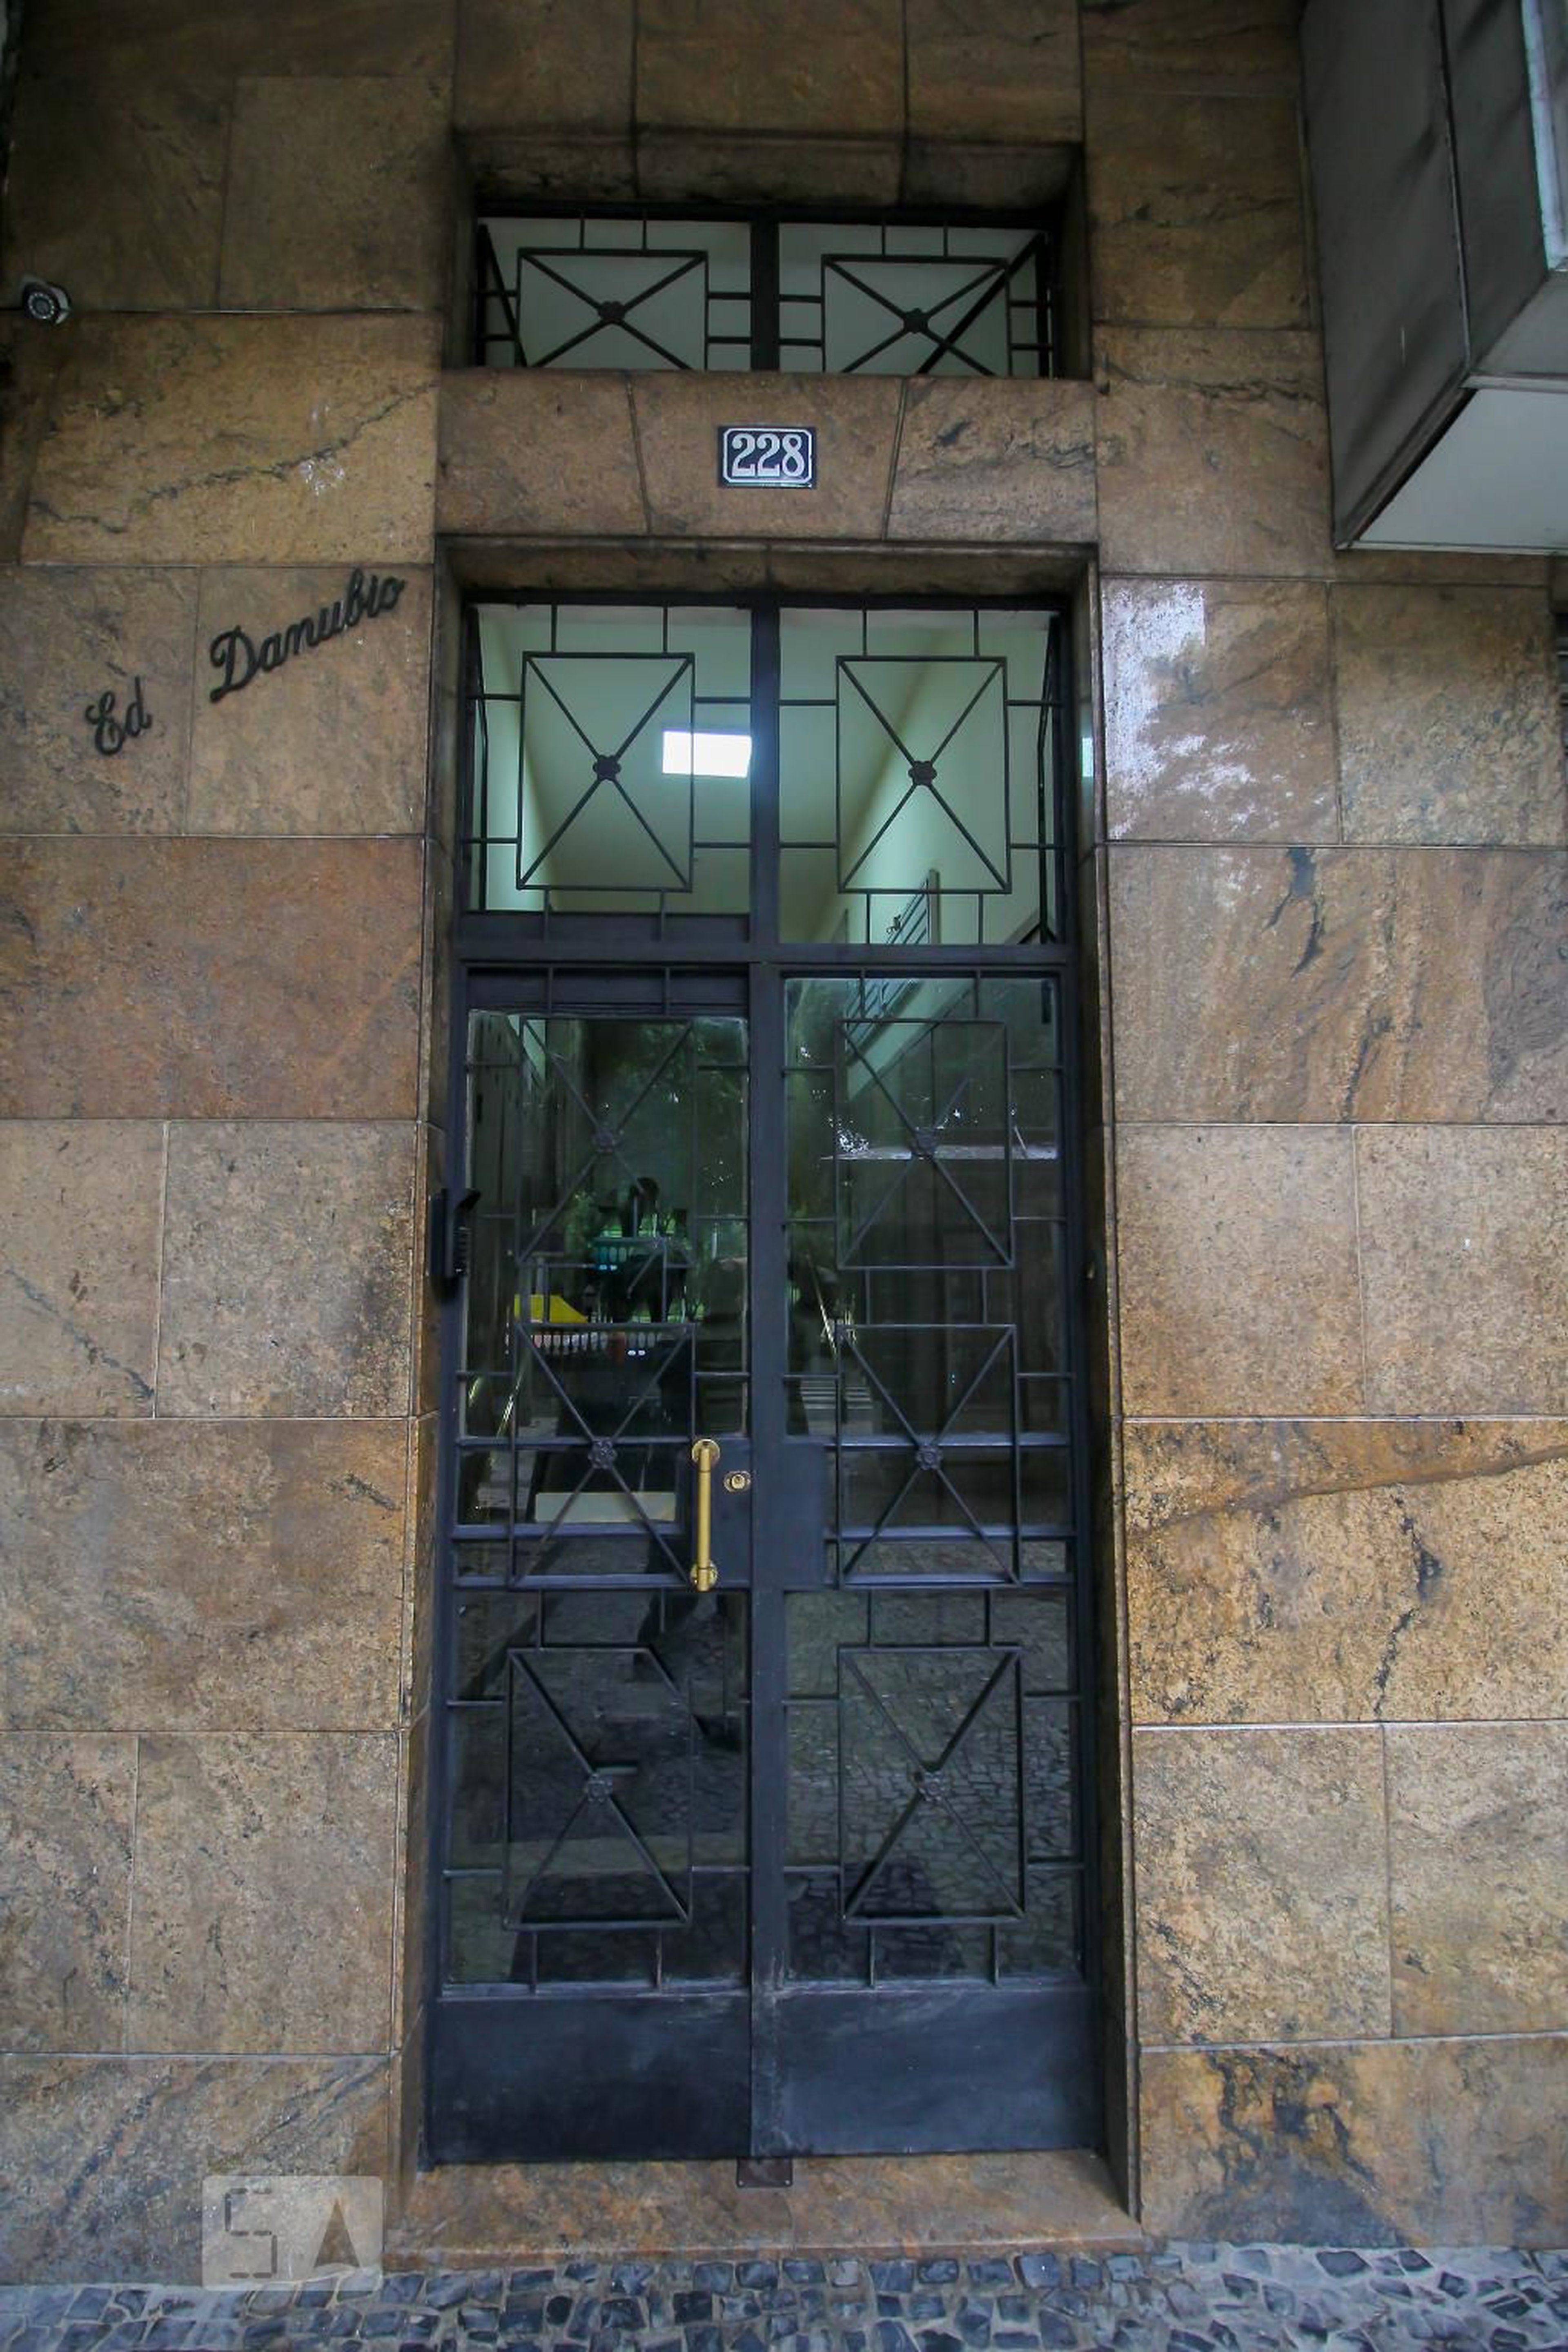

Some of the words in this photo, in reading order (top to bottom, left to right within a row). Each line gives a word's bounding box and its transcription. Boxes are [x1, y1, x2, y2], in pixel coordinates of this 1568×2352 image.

[731, 433, 805, 477] 228
[85, 675, 153, 755] Ed
[209, 567, 405, 703] Danubio
